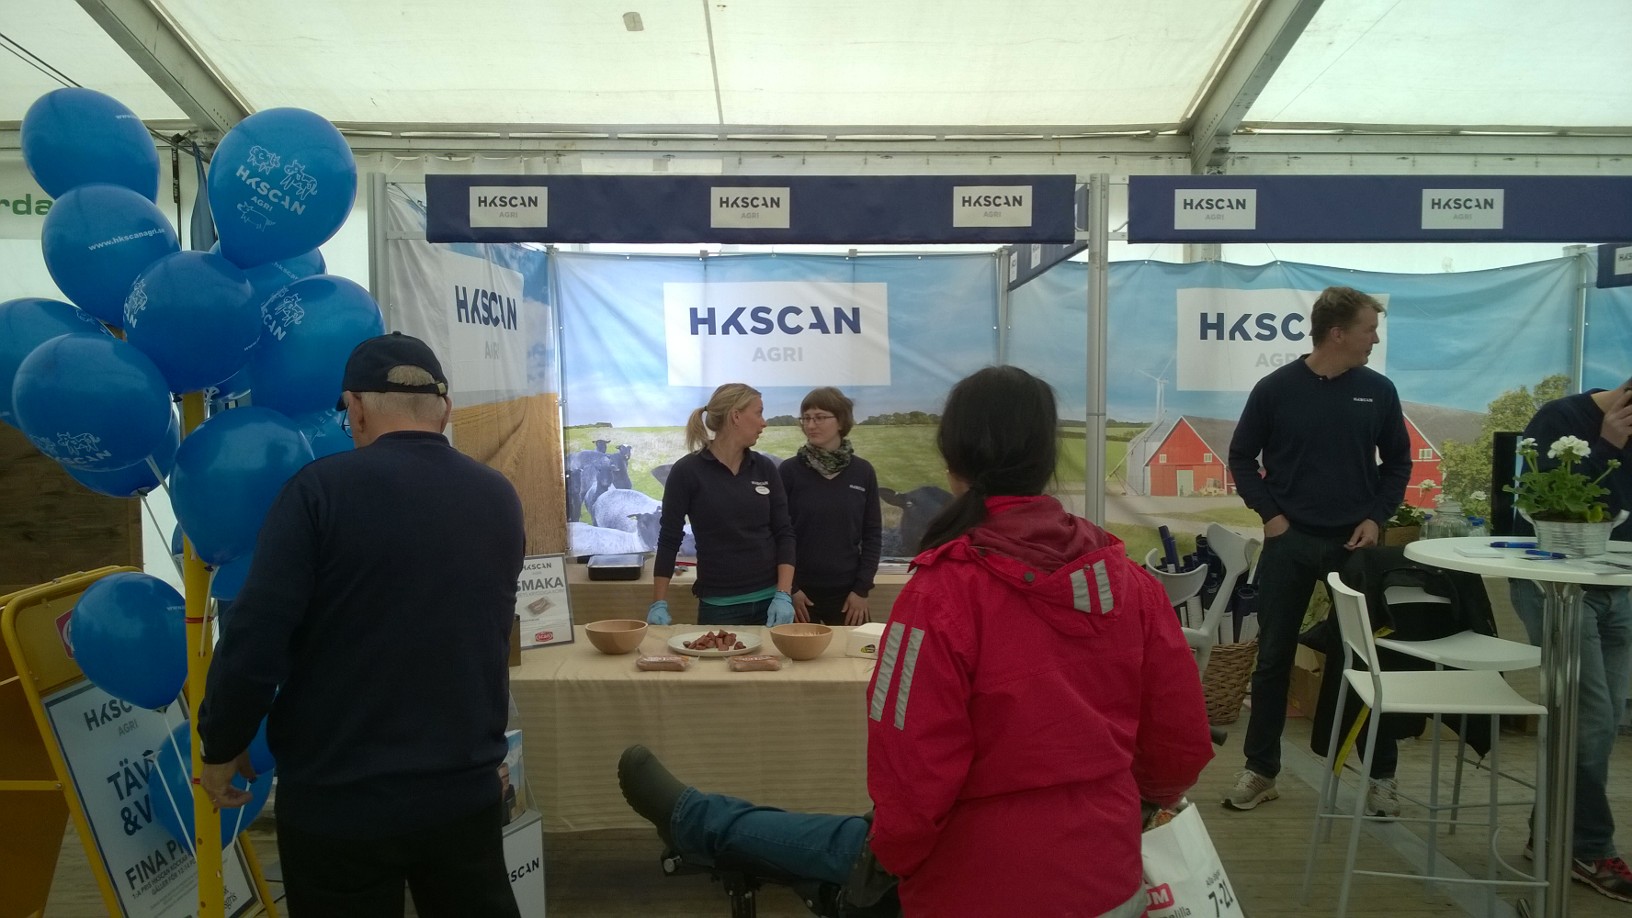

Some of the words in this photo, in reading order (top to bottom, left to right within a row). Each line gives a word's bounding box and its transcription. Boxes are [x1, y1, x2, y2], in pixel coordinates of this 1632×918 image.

[236, 165, 306, 215] HKSCAN
[250, 196, 273, 212] AGRI
[478, 195, 538, 208] HKSCAN
[719, 197, 780, 208] HKSCAN
[962, 195, 1022, 207] HKSCAN
[1183, 198, 1246, 210] HKSCAN
[1431, 198, 1494, 210] HKSCAN
[455, 285, 517, 331] HKSCAN
[689, 306, 862, 336] HKSCAN
[752, 347, 803, 362] AGRI
[118, 719, 139, 736] AGRI
[125, 850, 168, 890] FINA
[507, 857, 539, 882] SCAN
